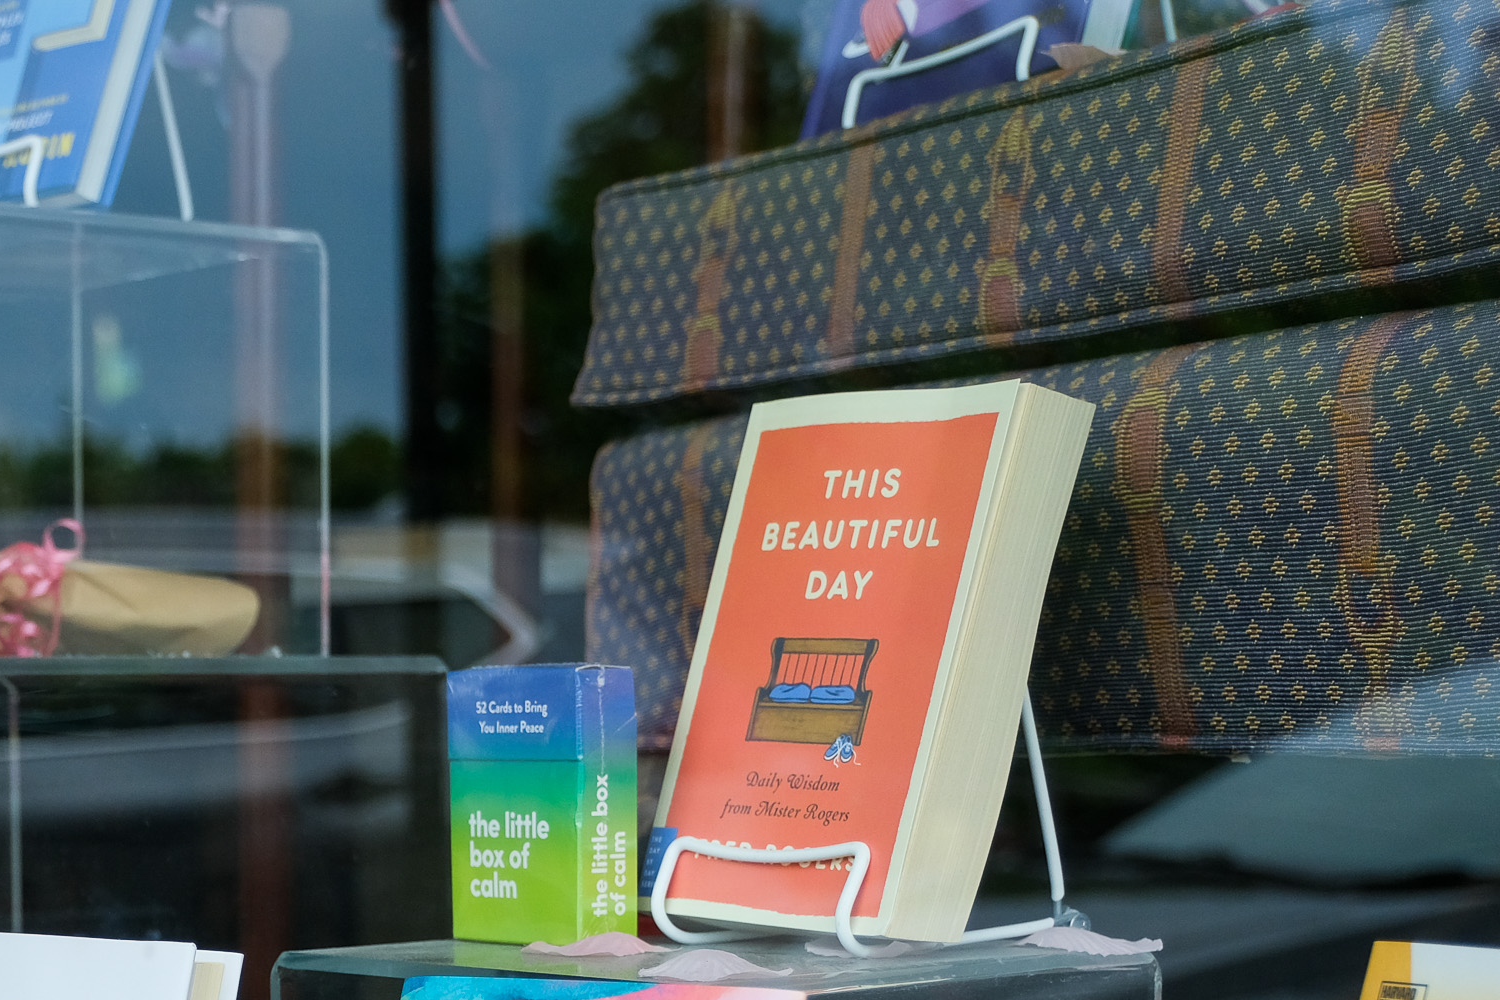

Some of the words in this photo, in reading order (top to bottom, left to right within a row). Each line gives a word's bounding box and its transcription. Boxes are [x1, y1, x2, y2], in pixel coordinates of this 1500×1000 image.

[823, 467, 902, 499] THIS
[761, 517, 939, 551] BEAUTIFUL
[804, 569, 873, 600] DAY
[475, 700, 488, 714] 52
[488, 701, 513, 714] Cards
[513, 702, 523, 714] to
[524, 700, 549, 718] Bring
[478, 720, 495, 734] You
[496, 720, 519, 734] Inner
[520, 720, 545, 734] Peace
[591, 774, 608, 816] box
[746, 770, 783, 792] Daily
[787, 772, 840, 793] Wisdom
[468, 810, 501, 839] the
[504, 811, 550, 839] little
[720, 798, 752, 820] from
[755, 801, 802, 819] Mister
[803, 803, 851, 827] Rogers
[469, 841, 505, 869] box
[509, 842, 531, 869] of
[591, 822, 608, 873] little
[610, 831, 626, 887] calm
[470, 871, 518, 899] calm
[591, 879, 608, 917] the
[610, 889, 626, 916] of
[1380, 985, 1416, 1000] HARVARD
